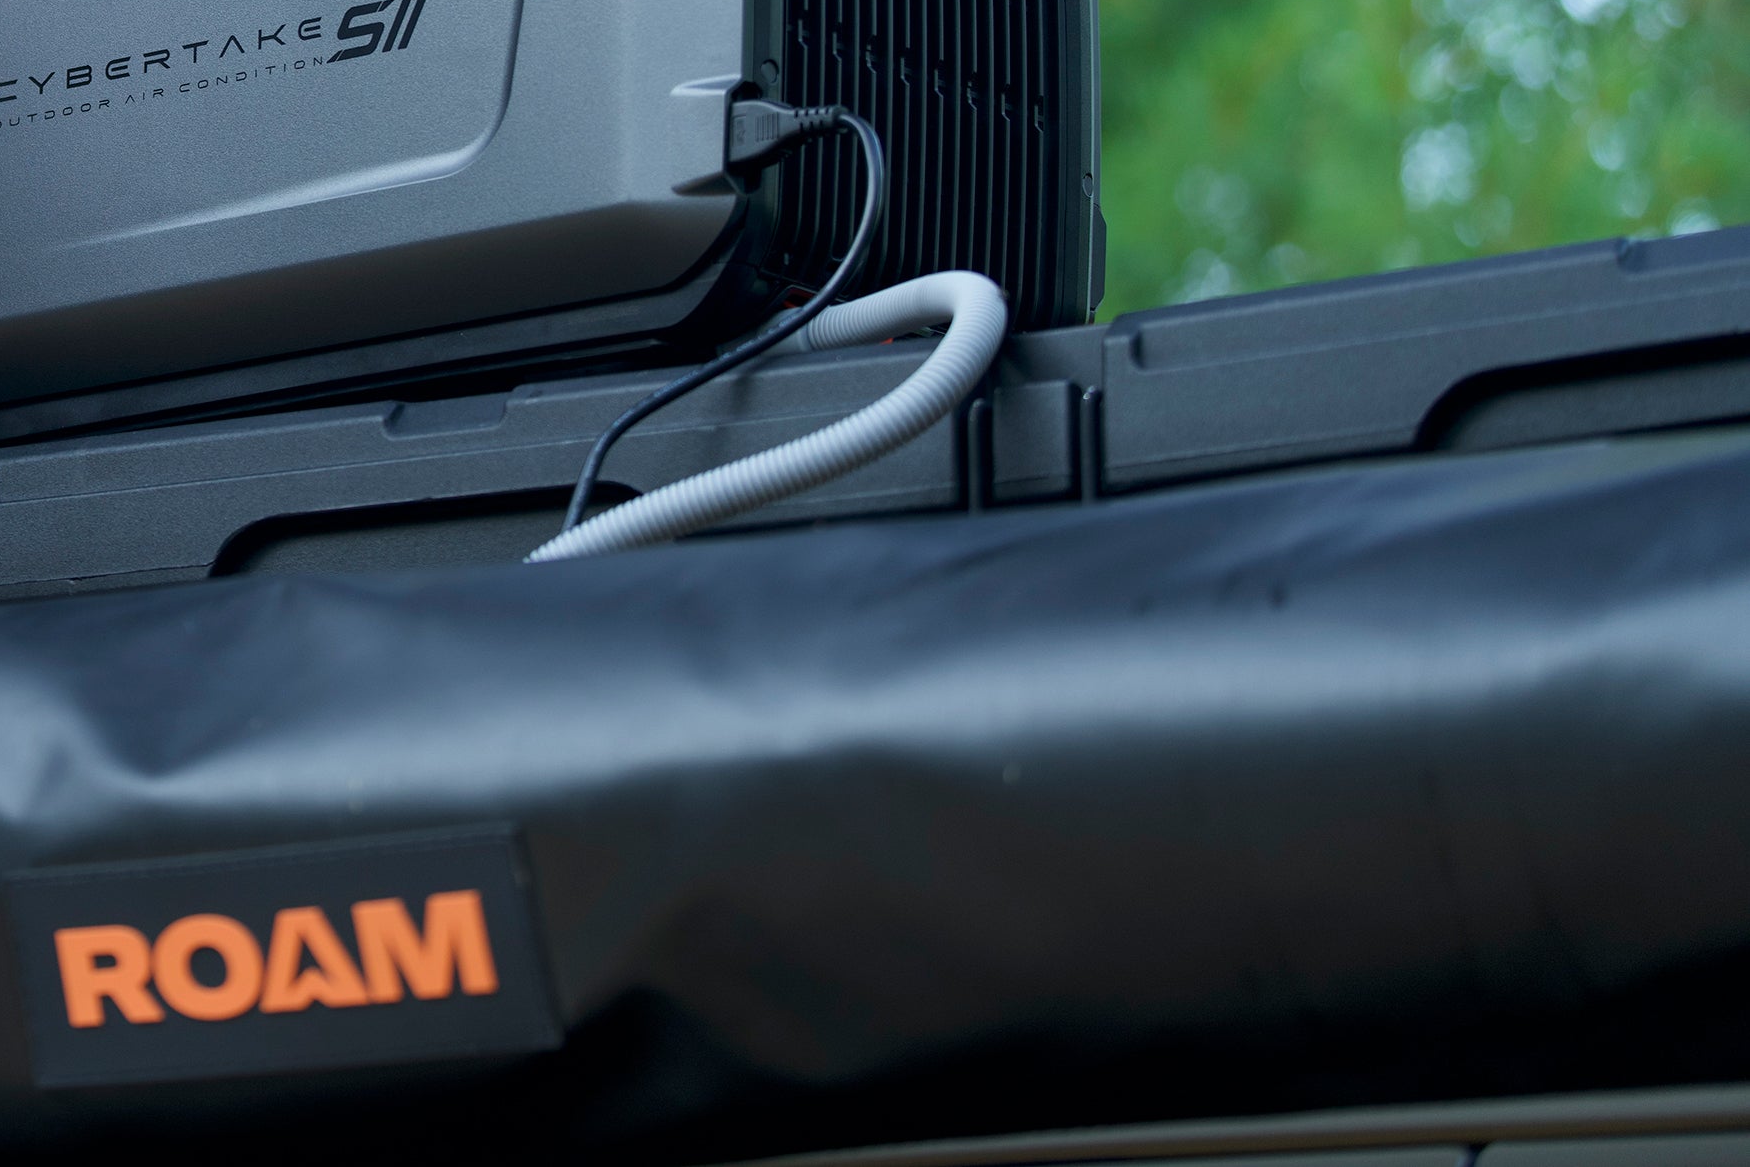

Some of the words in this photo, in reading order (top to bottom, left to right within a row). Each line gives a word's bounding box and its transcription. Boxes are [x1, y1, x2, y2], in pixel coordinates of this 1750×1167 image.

[125, 87, 165, 104] AIR
[178, 55, 324, 94] CONDITION
[53, 889, 499, 1029] ROAM
